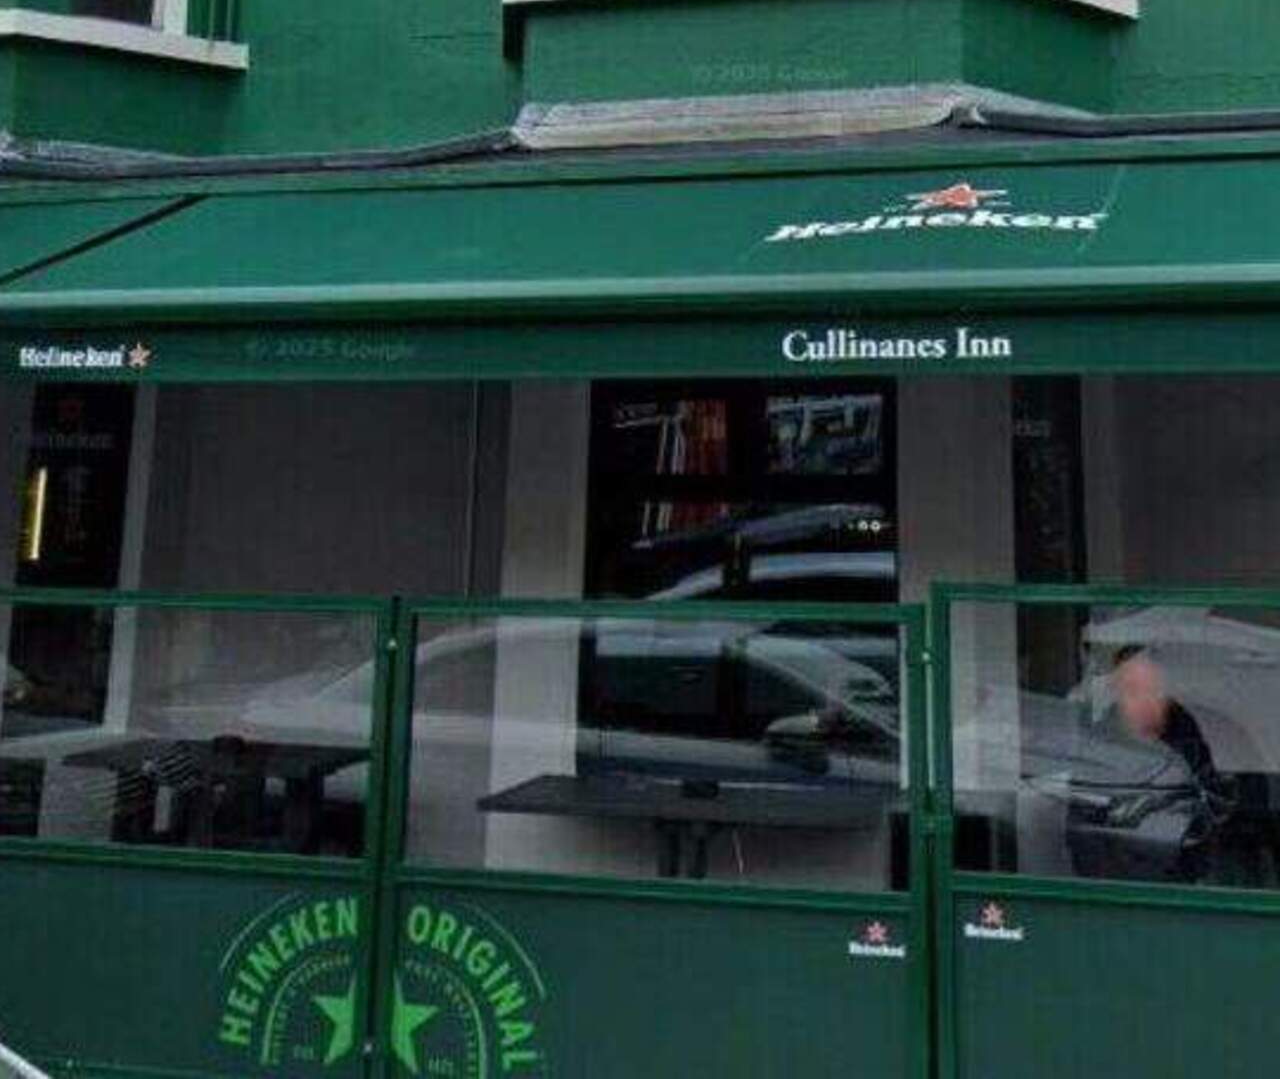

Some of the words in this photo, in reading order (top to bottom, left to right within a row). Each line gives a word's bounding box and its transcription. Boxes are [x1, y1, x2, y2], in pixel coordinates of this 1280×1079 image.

[765, 210, 1108, 242] Heineken
[782, 328, 946, 361] Cullinanes
[956, 326, 1012, 358] Inn
[220, 897, 360, 1046] HEINEKEN
[407, 905, 540, 1072] ORIGINAL
